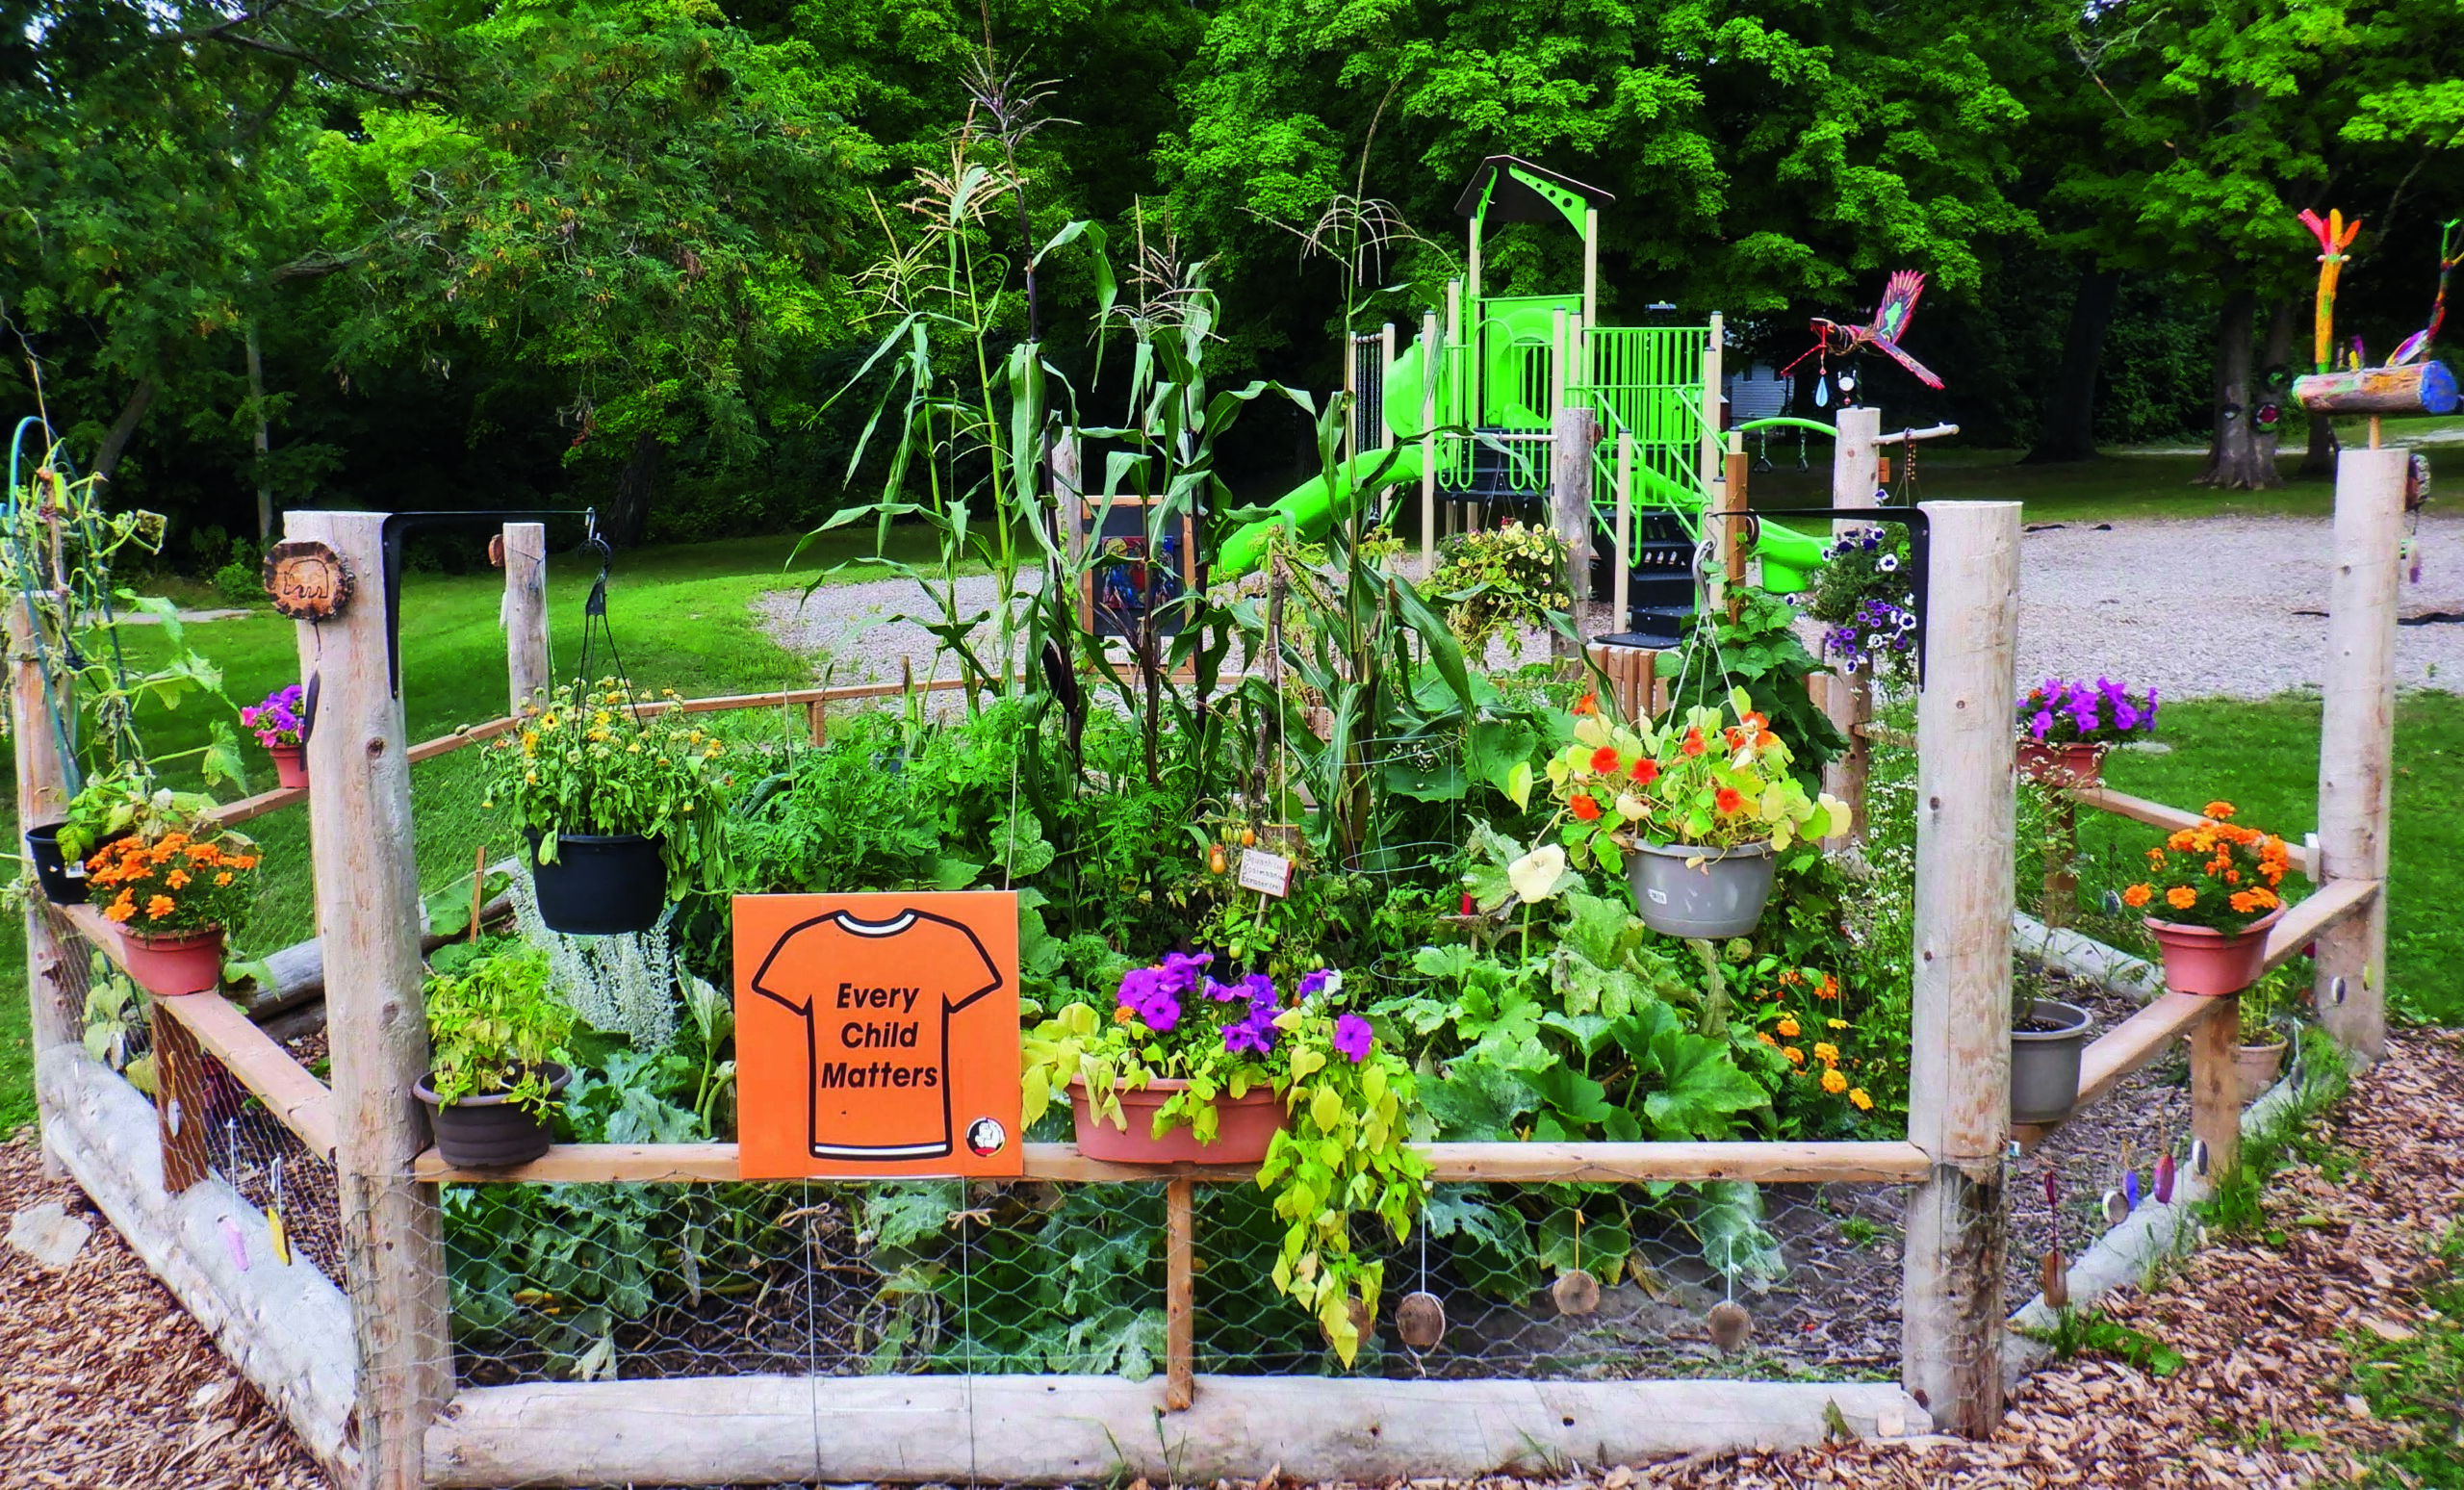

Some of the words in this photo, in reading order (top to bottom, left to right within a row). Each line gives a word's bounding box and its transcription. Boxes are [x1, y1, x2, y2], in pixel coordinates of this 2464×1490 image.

[836, 983, 920, 1013] Every
[841, 1022, 918, 1048] Child
[821, 1062, 938, 1089] Matters
